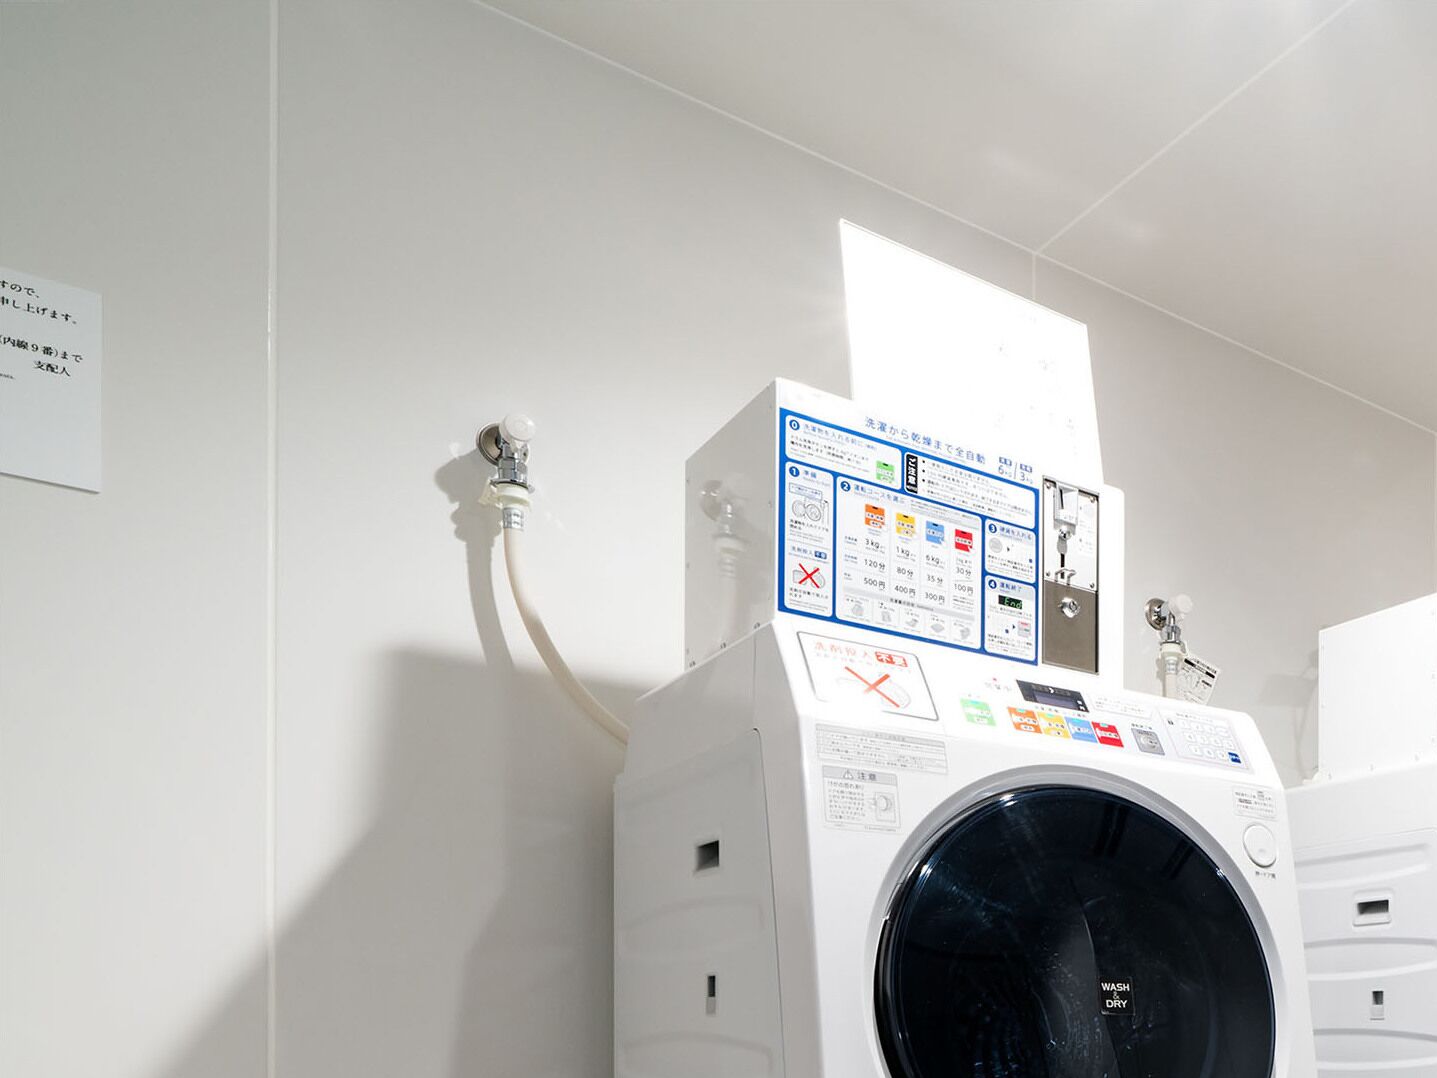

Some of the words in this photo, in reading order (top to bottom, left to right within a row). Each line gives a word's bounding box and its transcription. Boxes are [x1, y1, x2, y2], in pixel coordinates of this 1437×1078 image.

[33, 359, 71, 377] 支配人
[864, 416, 986, 465] 洗濯から乾燥まで全自動
[1101, 982, 1130, 992] WASH
[1105, 999, 1128, 1008] DRY
